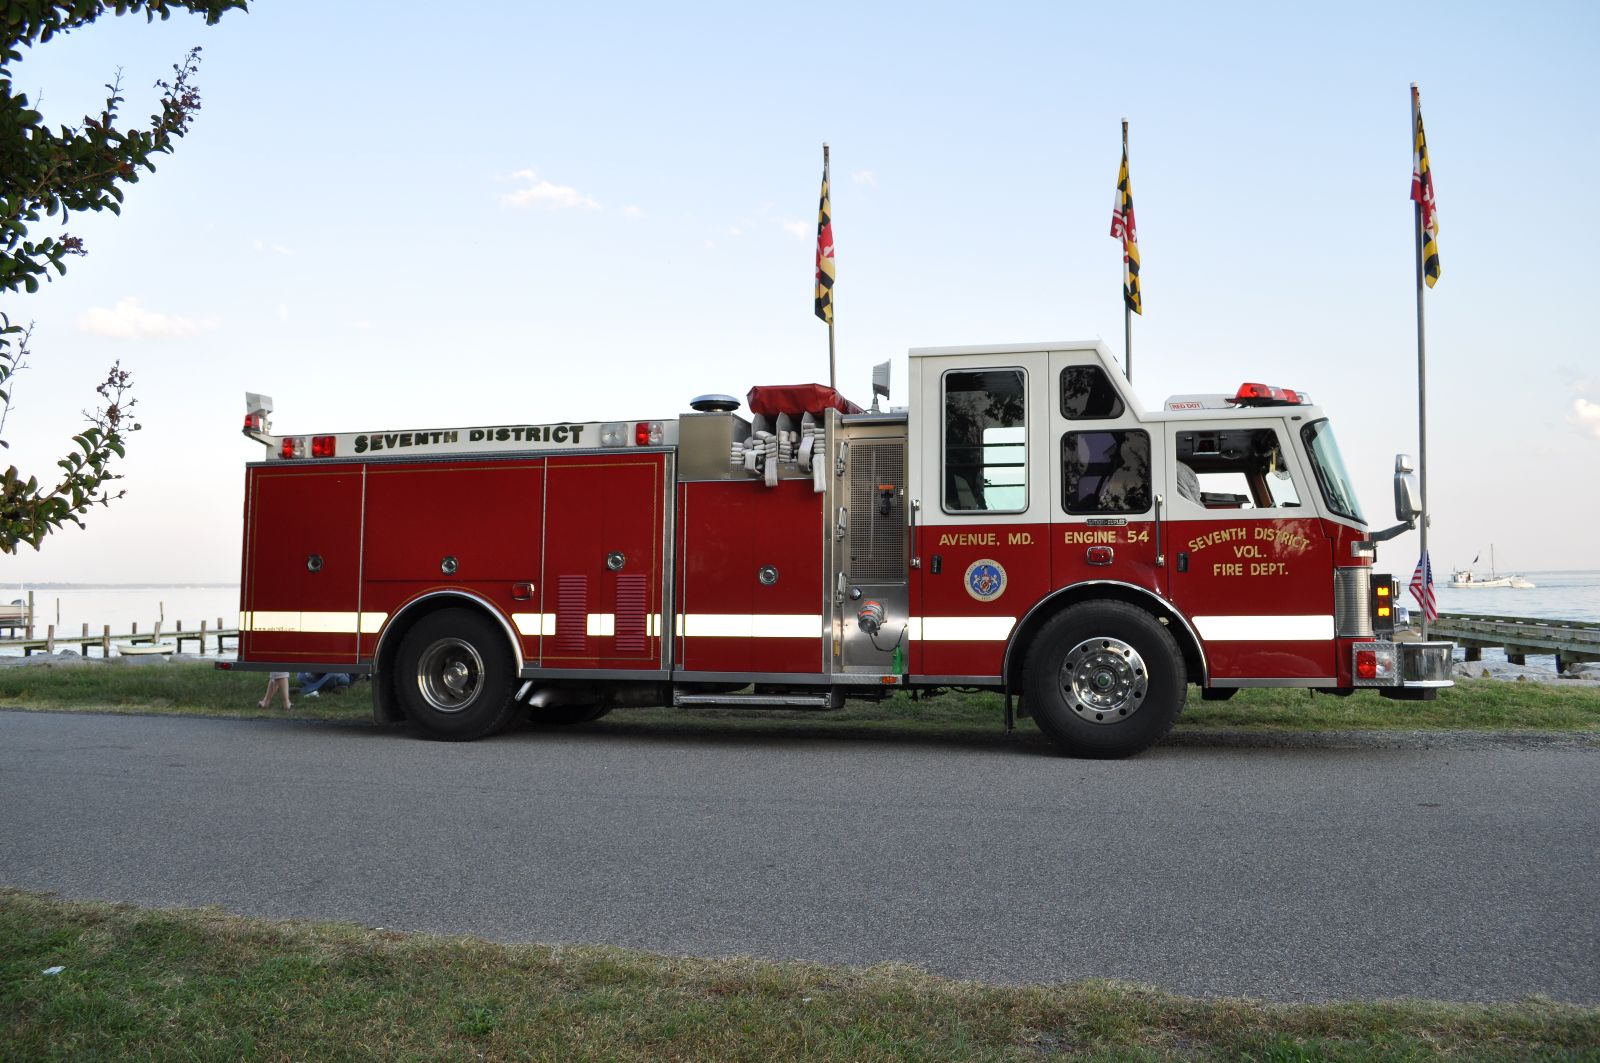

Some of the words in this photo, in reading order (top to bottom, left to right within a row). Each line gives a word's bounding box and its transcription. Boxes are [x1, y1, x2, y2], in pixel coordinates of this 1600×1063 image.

[354, 430, 458, 453] SEVENTH
[469, 425, 584, 444] DISTRICT
[939, 533, 1000, 546] AVENUE,
[1008, 533, 1035, 545] MD.
[1064, 531, 1116, 544] ENGINE
[1127, 531, 1150, 543] 54
[1188, 528, 1246, 552] SEVENTH
[1254, 527, 1310, 551] DISTRICT
[1233, 545, 1267, 558] VOL.
[1213, 563, 1243, 576] FIRE
[1250, 563, 1289, 576] DEPT.
